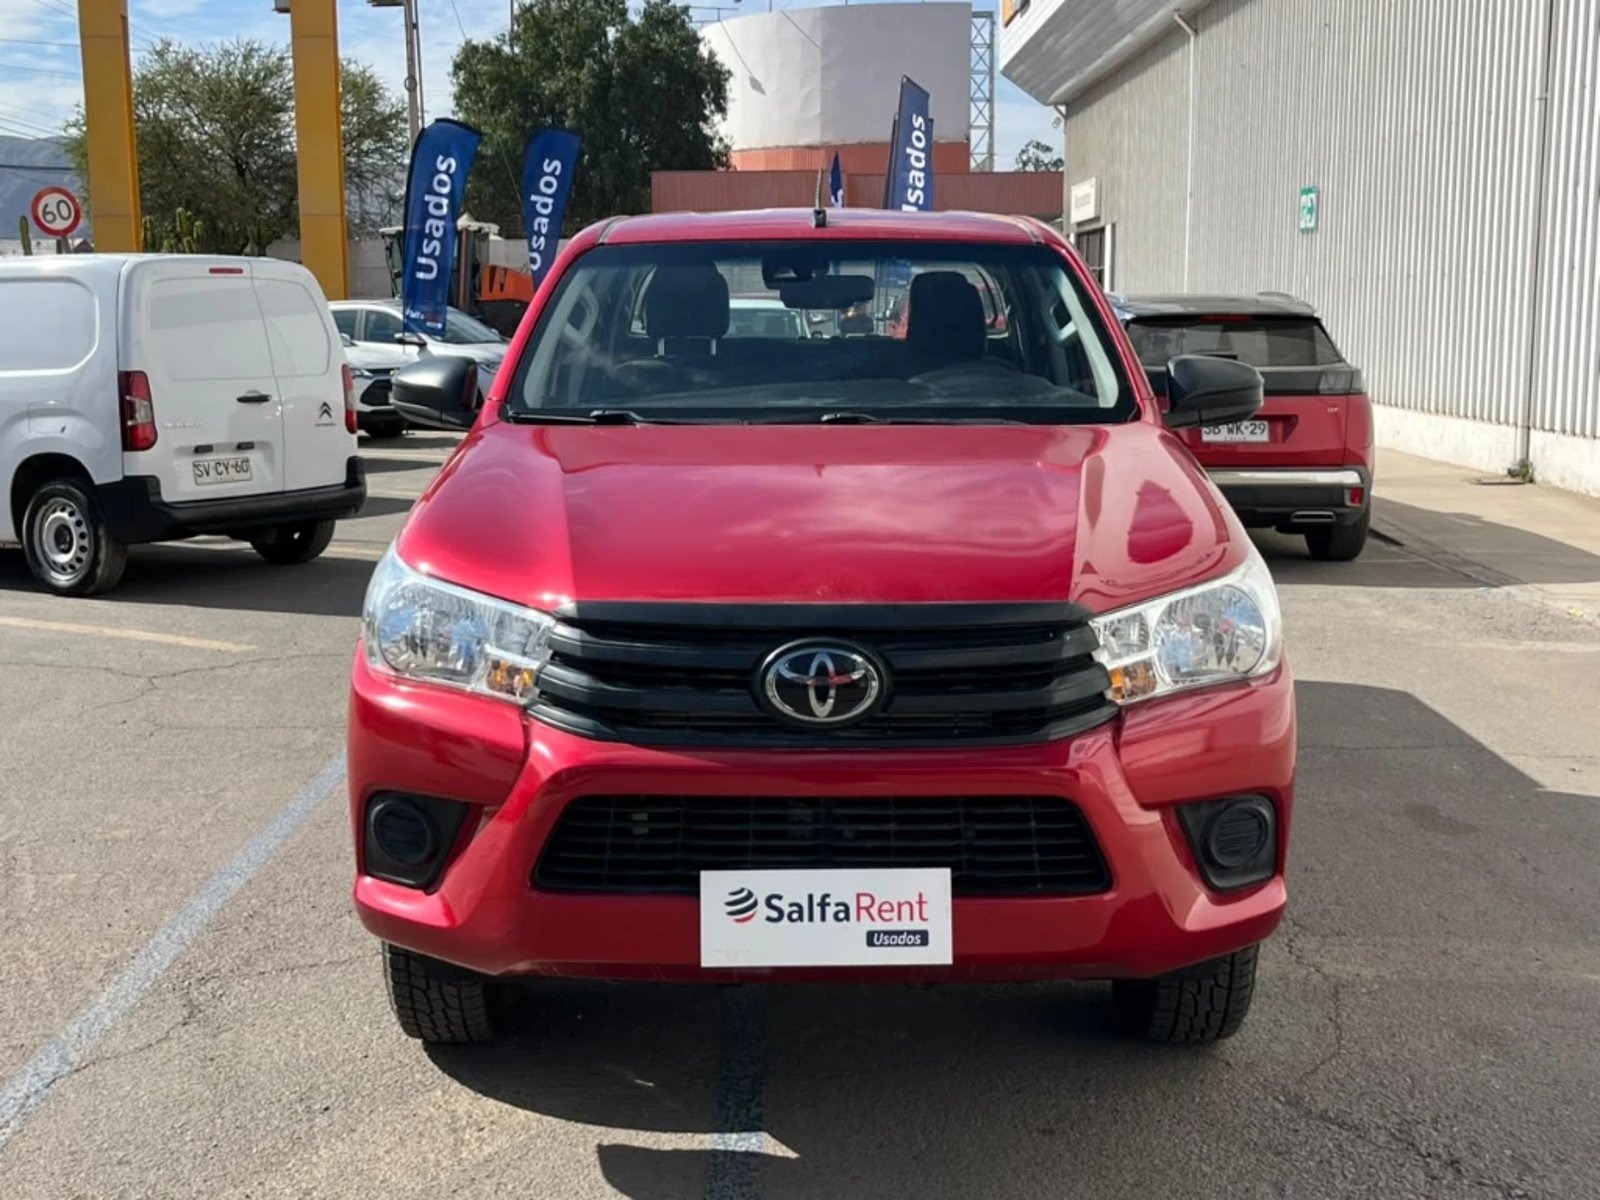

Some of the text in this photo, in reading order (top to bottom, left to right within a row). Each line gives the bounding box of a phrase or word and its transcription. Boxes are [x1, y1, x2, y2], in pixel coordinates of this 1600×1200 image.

[902, 114, 926, 211] sados
[42, 199, 72, 224] 60
[415, 154, 457, 281] Usados
[765, 892, 929, 923] SalfaRent
[873, 932, 921, 945] Usados
